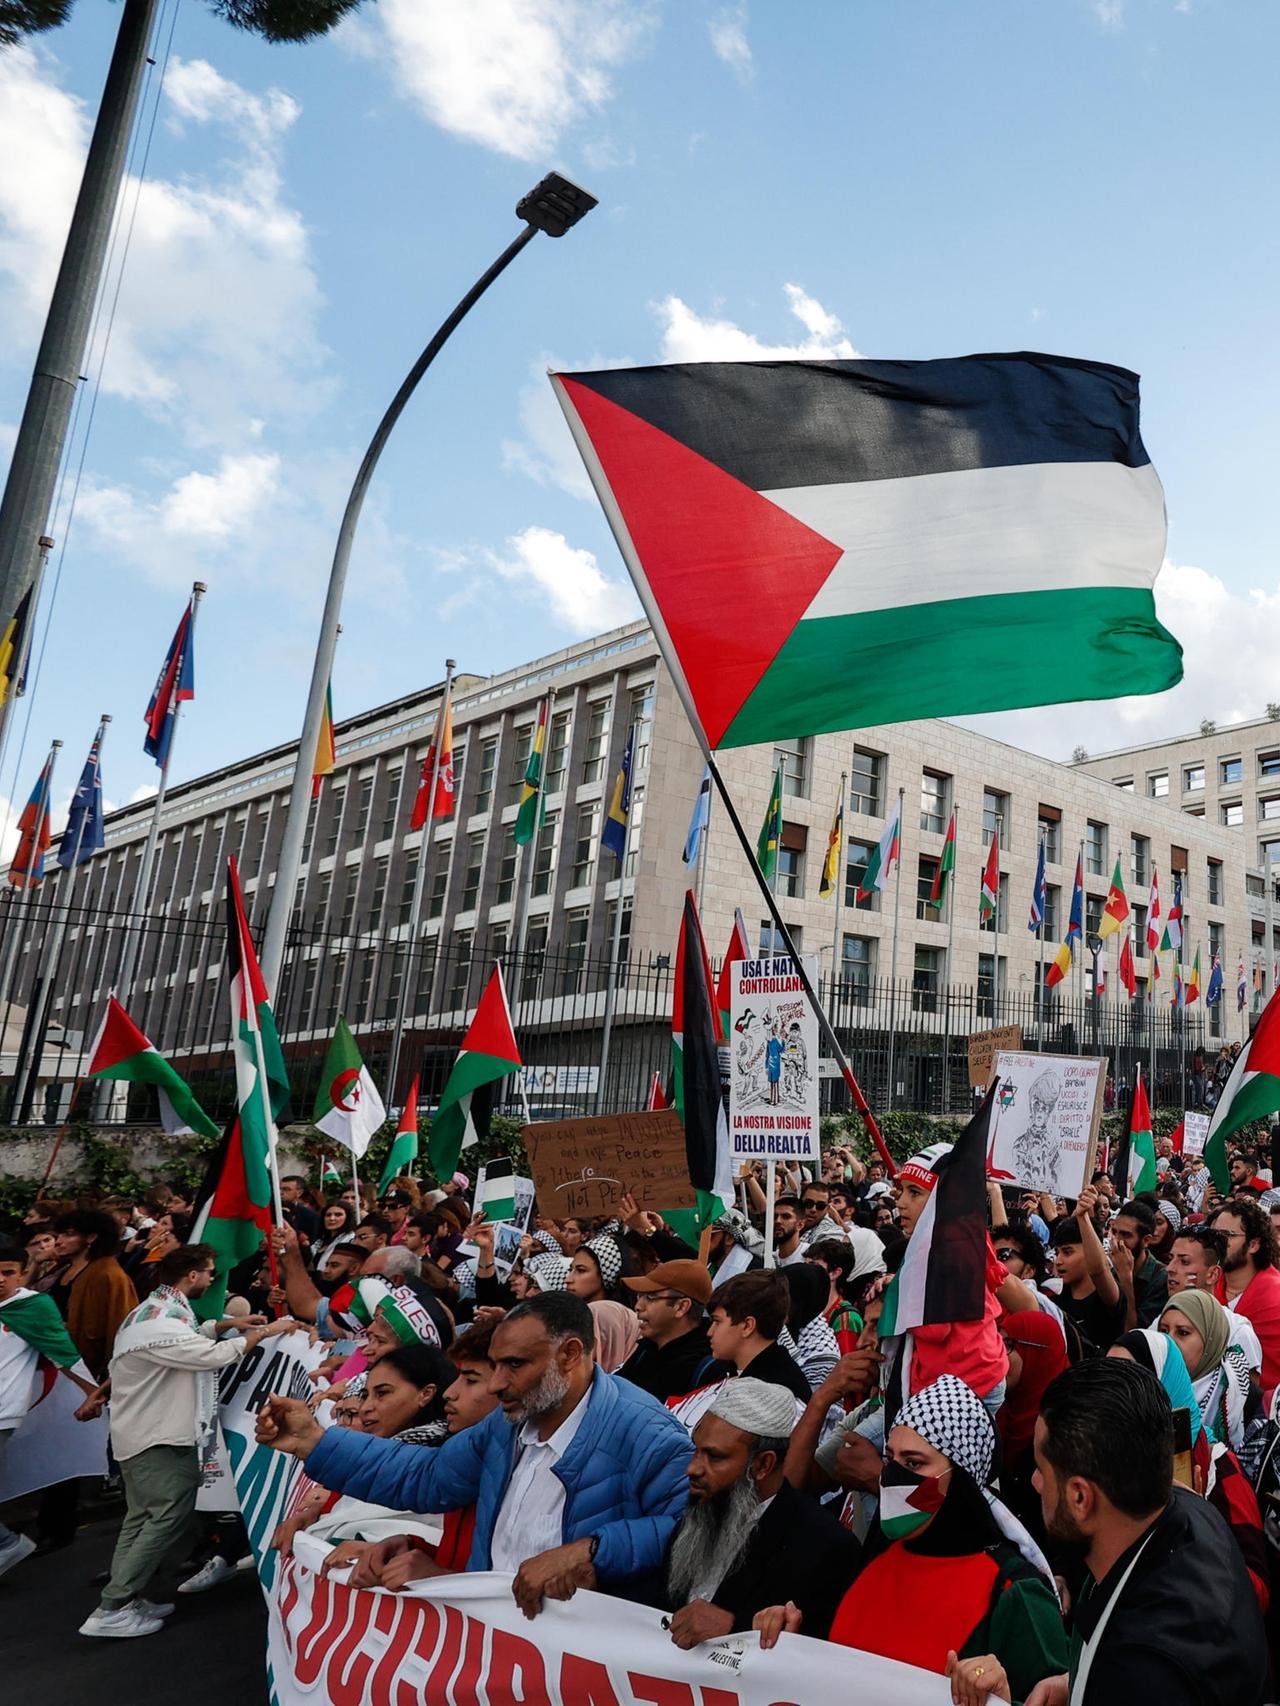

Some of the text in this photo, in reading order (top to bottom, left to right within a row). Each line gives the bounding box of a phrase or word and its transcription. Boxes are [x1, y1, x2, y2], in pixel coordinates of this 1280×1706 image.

[742, 960, 762, 978] USA
[764, 959, 770, 976] E
[733, 1115, 812, 1130] LA NOSTRA VISIONE
[734, 1134, 765, 1153] DELLA
[615, 1144, 663, 1162] Peace
